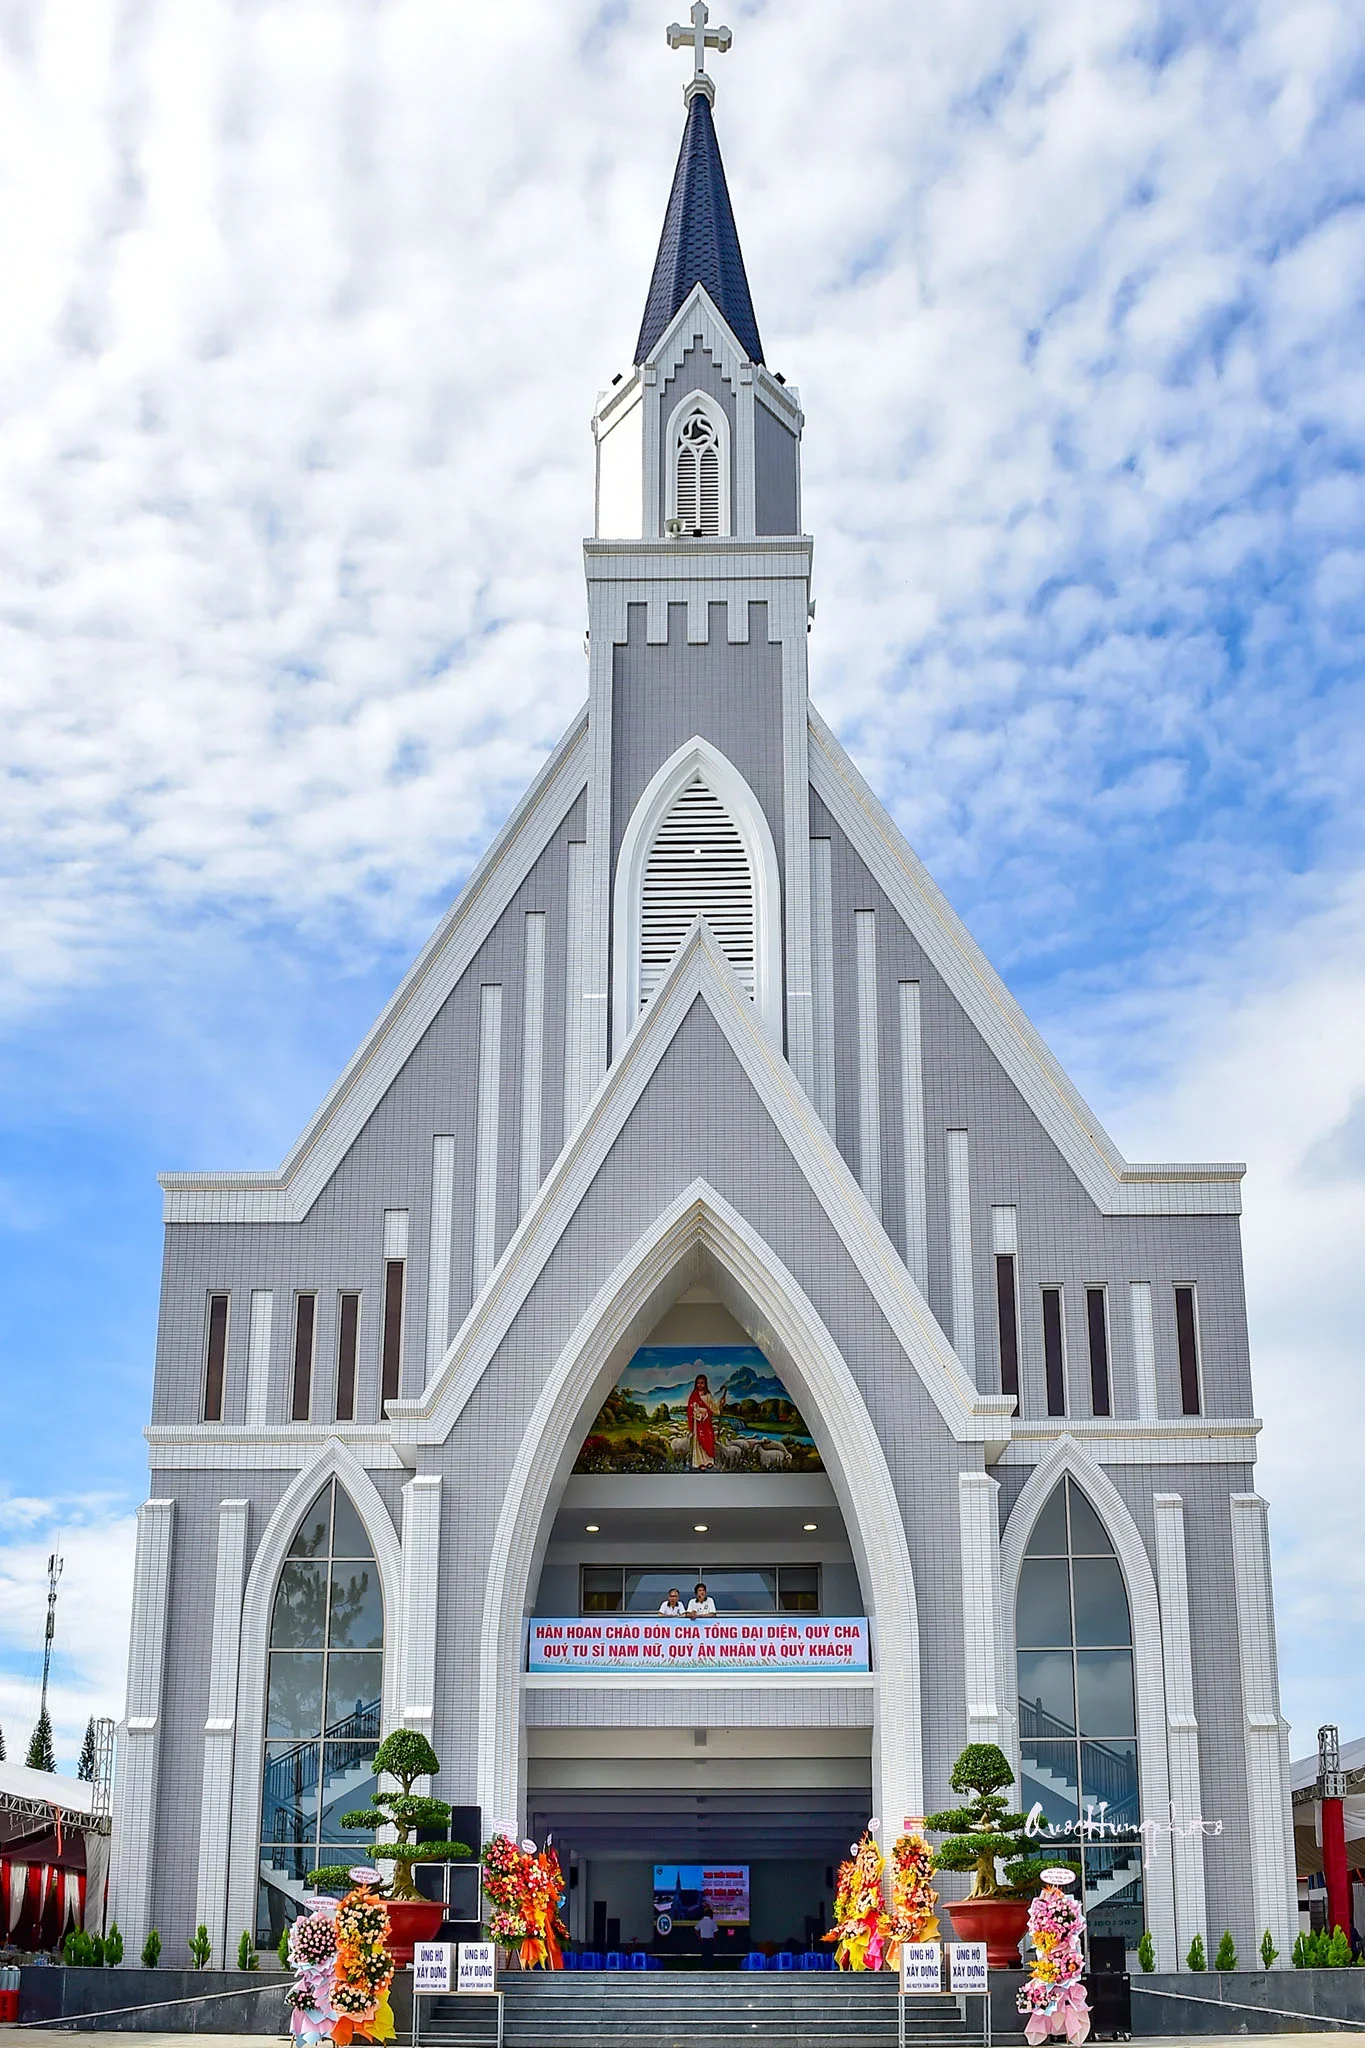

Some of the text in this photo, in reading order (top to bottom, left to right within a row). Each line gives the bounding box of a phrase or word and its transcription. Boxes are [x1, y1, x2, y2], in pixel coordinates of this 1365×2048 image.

[536, 1622, 860, 1641] HÂN HOAN CHÀO ĐÓN CHA TỔNG ĐẠI DIỆN, QUÝ CHA
[543, 1642, 852, 1658] QUÝ TU SĨ NAM NỮ, QUÝ ÂN NHÂN VÀ QUÝ KHÁCH
